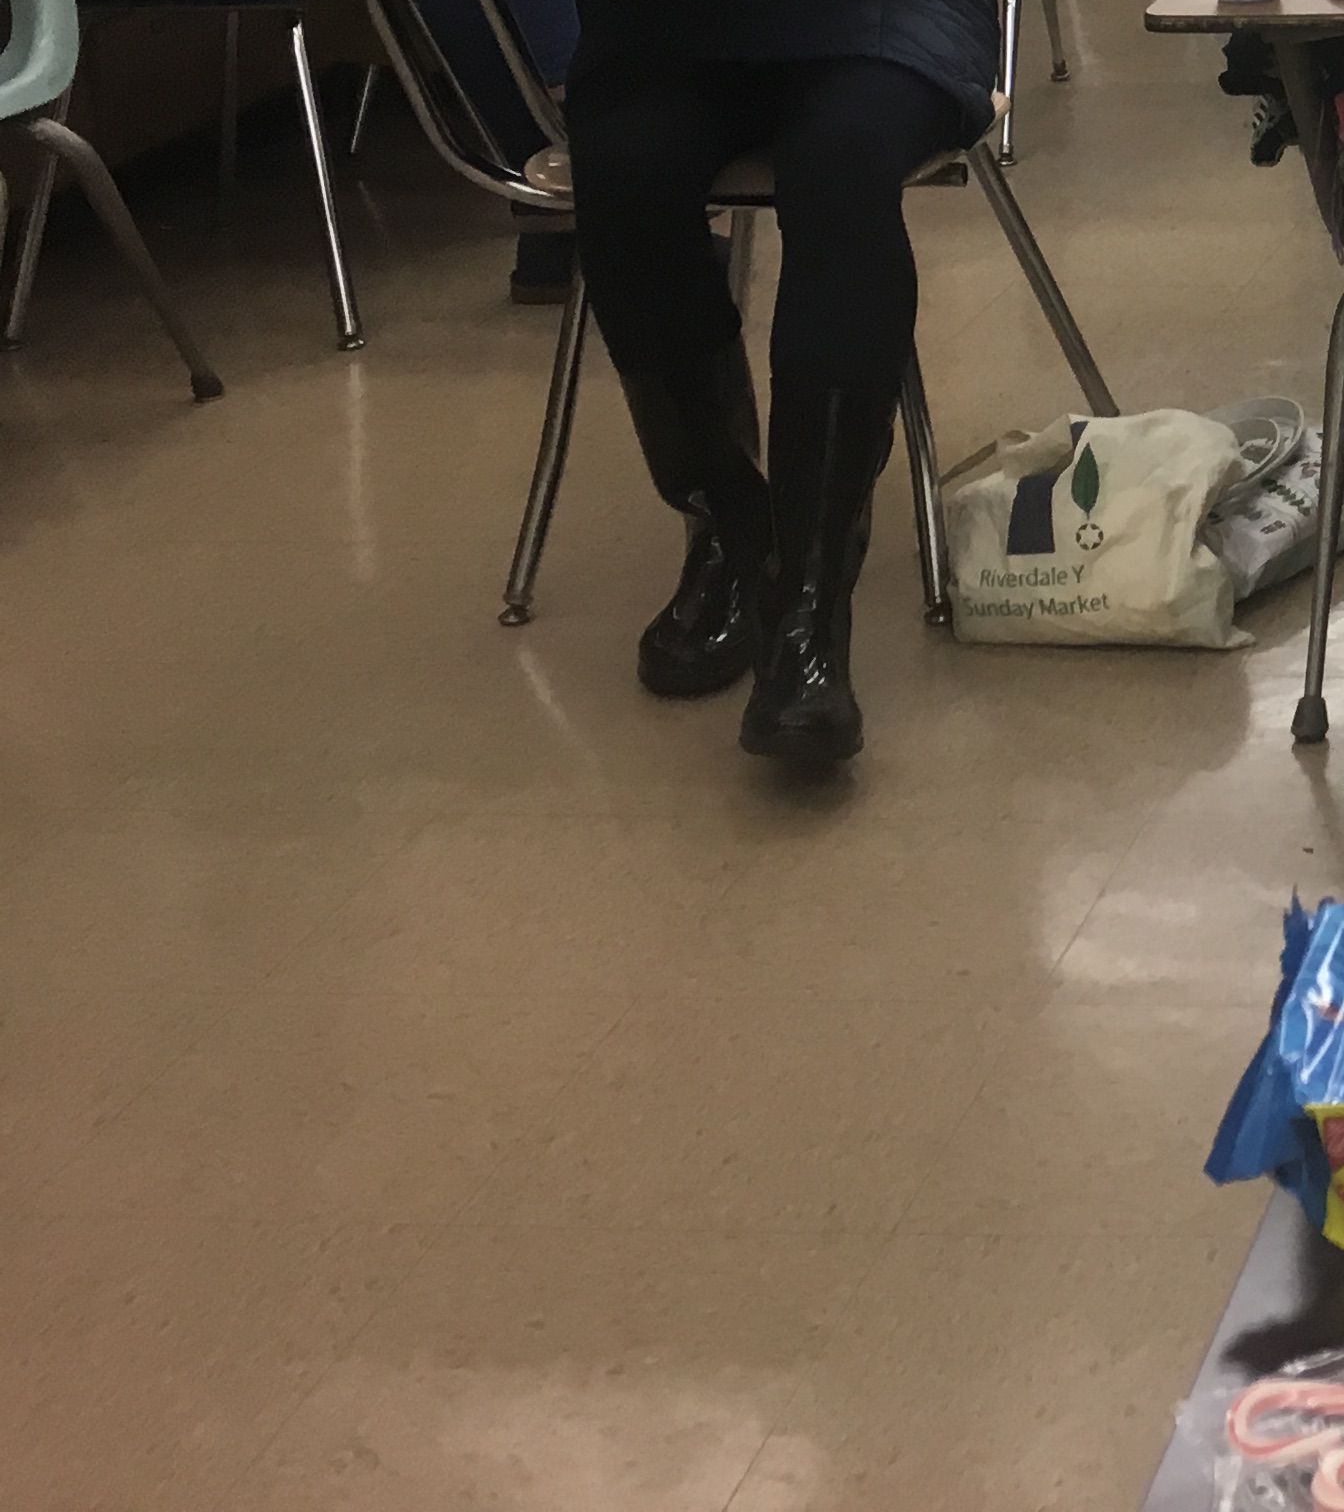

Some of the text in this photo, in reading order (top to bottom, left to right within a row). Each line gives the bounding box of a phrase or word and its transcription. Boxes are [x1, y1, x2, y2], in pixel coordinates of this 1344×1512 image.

[979, 563, 1085, 588] Riverdale Y
[962, 592, 1111, 620] Sunday Market
